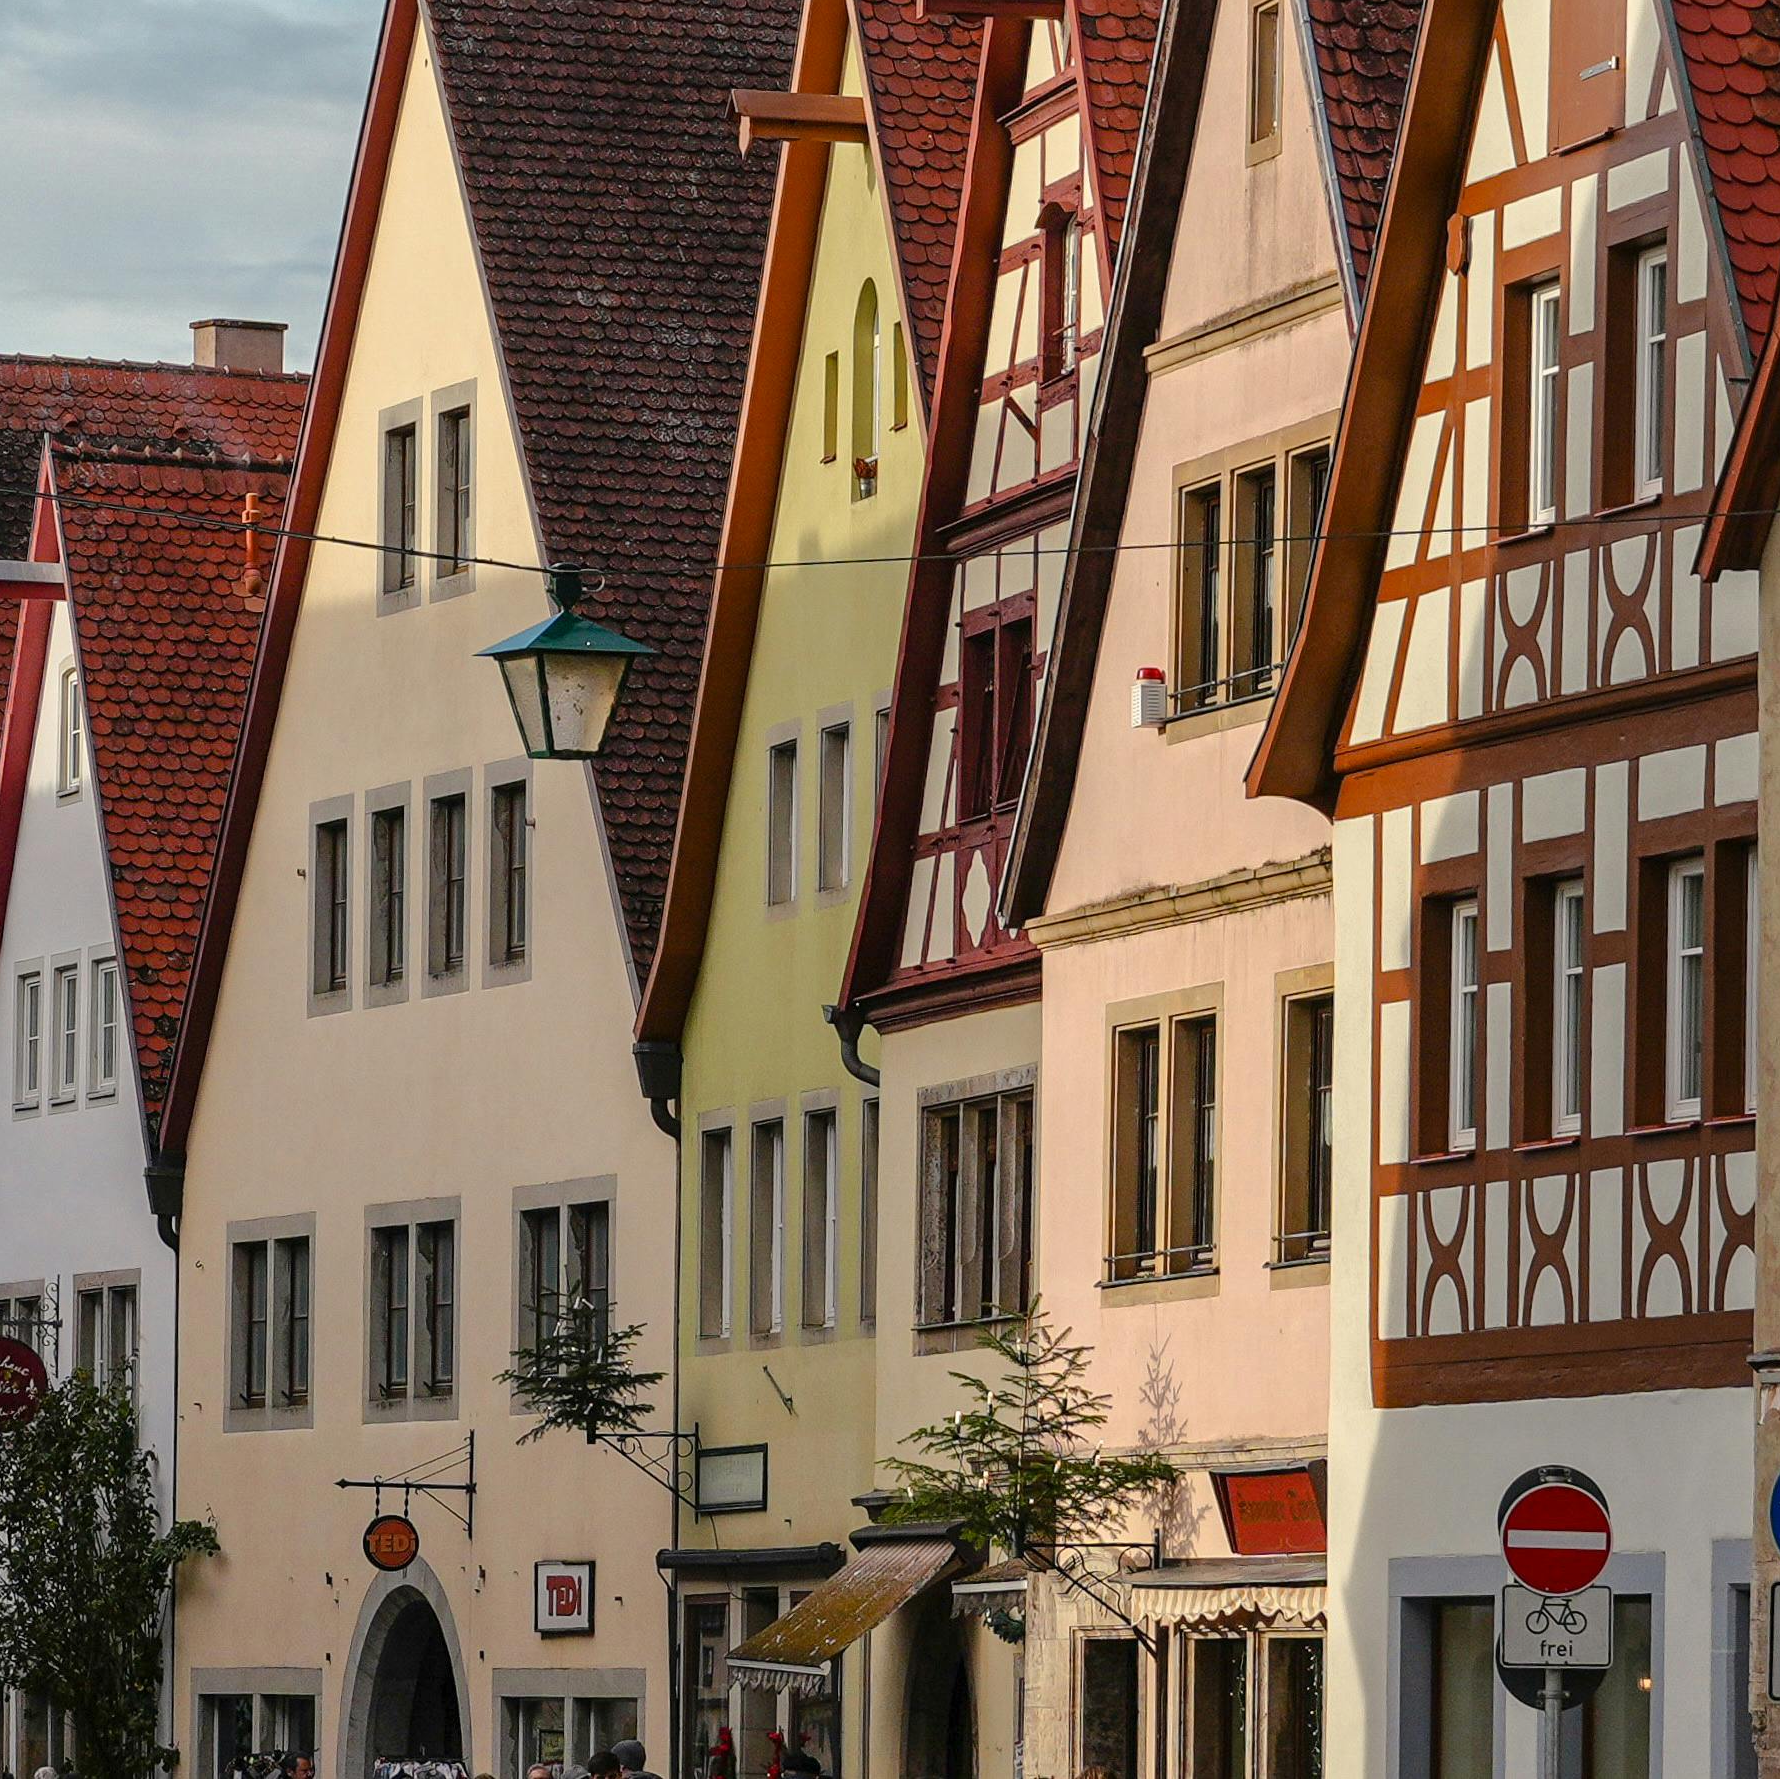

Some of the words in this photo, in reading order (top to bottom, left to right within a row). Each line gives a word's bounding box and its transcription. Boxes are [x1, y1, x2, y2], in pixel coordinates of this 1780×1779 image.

[366, 1534, 416, 1553] TEDi
[546, 1575, 582, 1617] TEDi
[1540, 1639, 1573, 1657] frei
